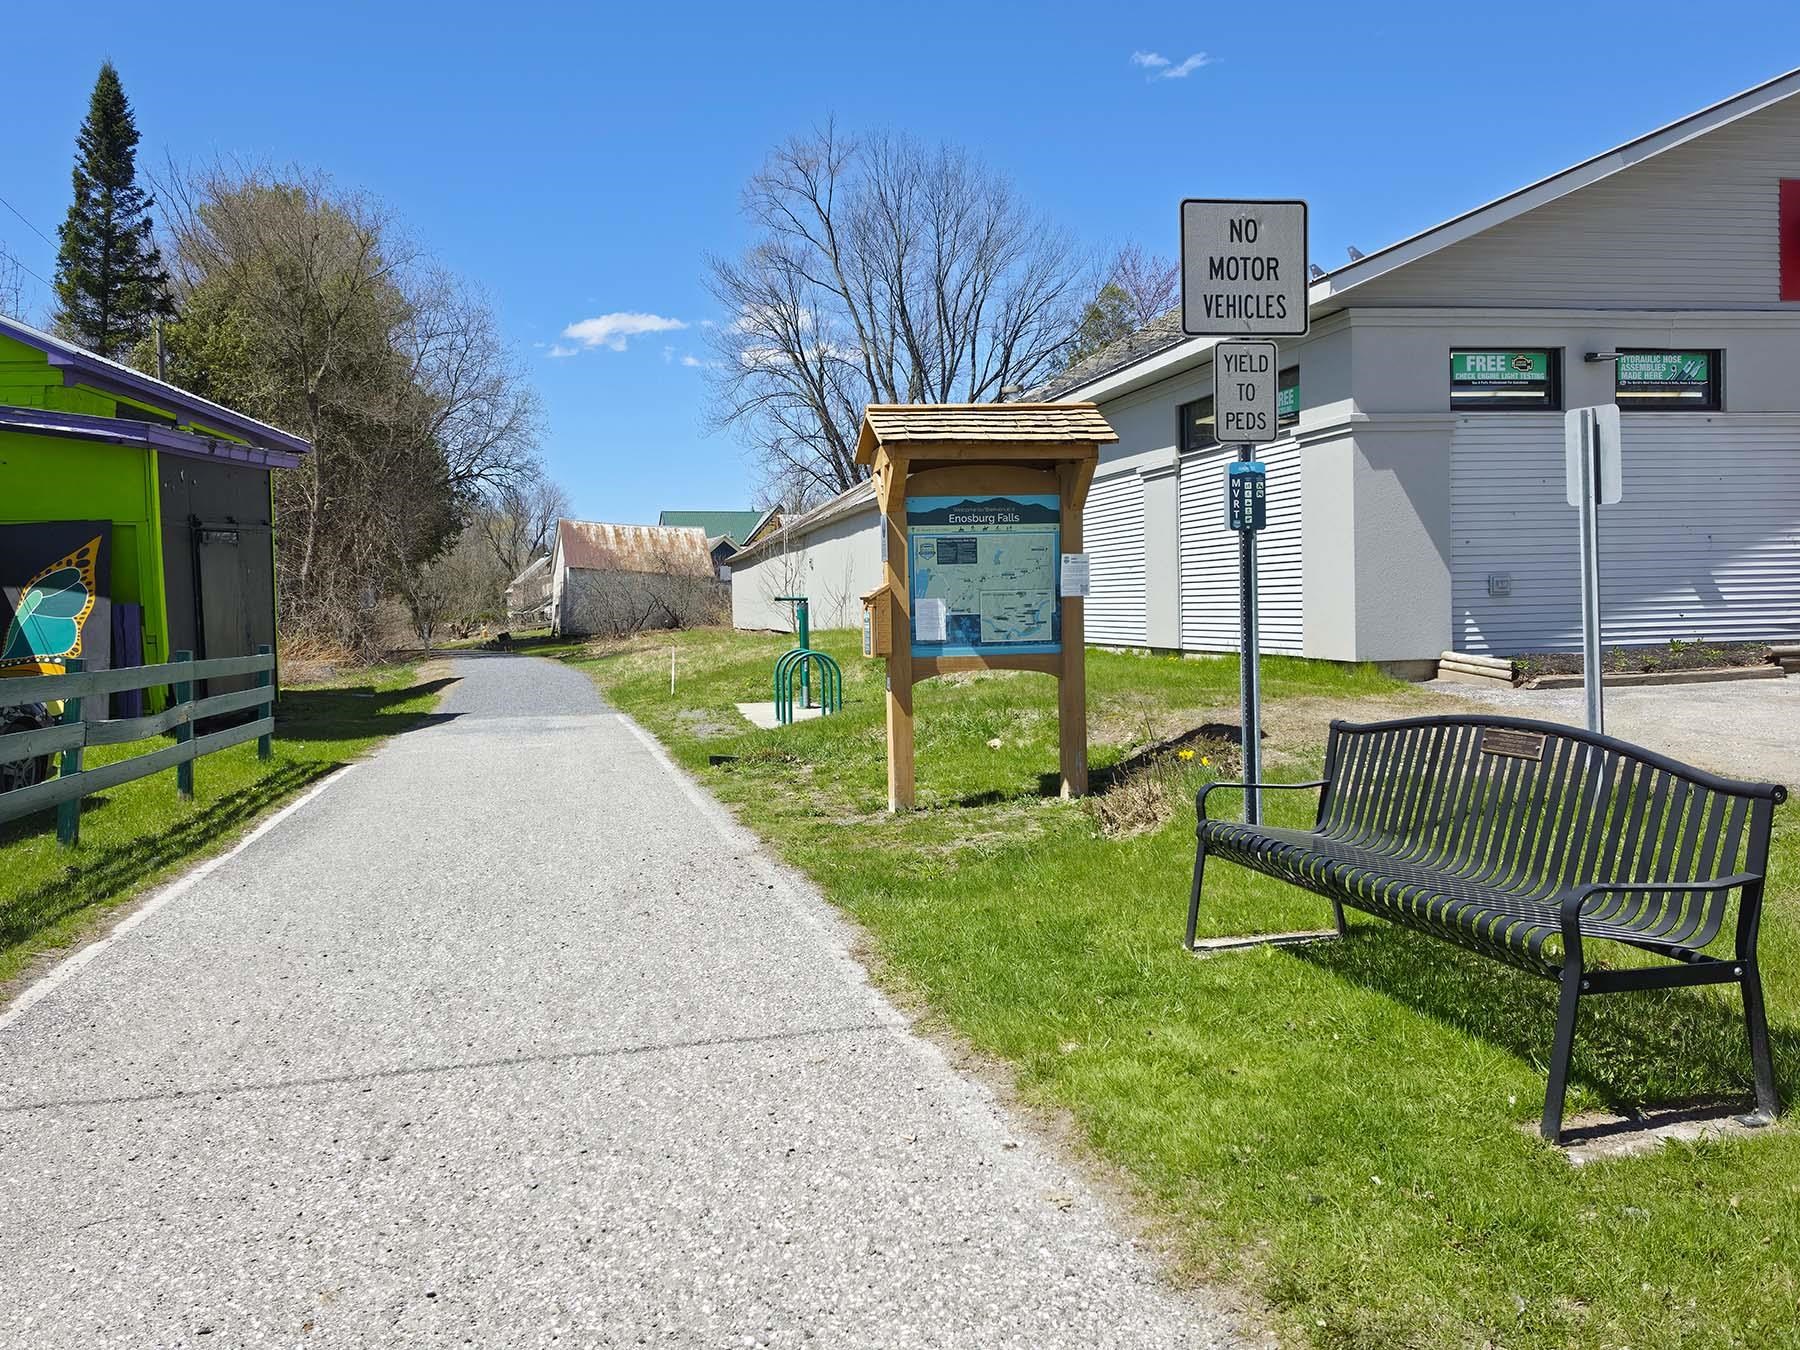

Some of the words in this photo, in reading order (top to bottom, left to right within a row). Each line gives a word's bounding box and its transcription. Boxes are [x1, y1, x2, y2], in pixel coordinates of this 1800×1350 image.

[1230, 218, 1258, 243] NO
[1209, 256, 1280, 281] MOTOR
[1203, 294, 1287, 319] VEHICLES
[1223, 354, 1268, 373] YIELD
[1466, 355, 1506, 372] FREE
[1620, 355, 1661, 363] HYDRAULIC
[1662, 355, 1682, 363] HOSE
[1621, 363, 1666, 372] ASSEMBLIES
[1455, 372, 1476, 380] CHECK
[1477, 372, 1499, 380] ENGINE
[1501, 372, 1518, 380] LIGHT
[1519, 372, 1545, 380] TESTING
[1621, 371, 1643, 380] MADE
[1644, 371, 1663, 380] HERE
[1236, 383, 1256, 402] TO
[1278, 389, 1294, 407] REE
[1226, 412, 1266, 430] PEDS
[948, 513, 995, 525] Enosburg
[997, 513, 1020, 522] Falls
